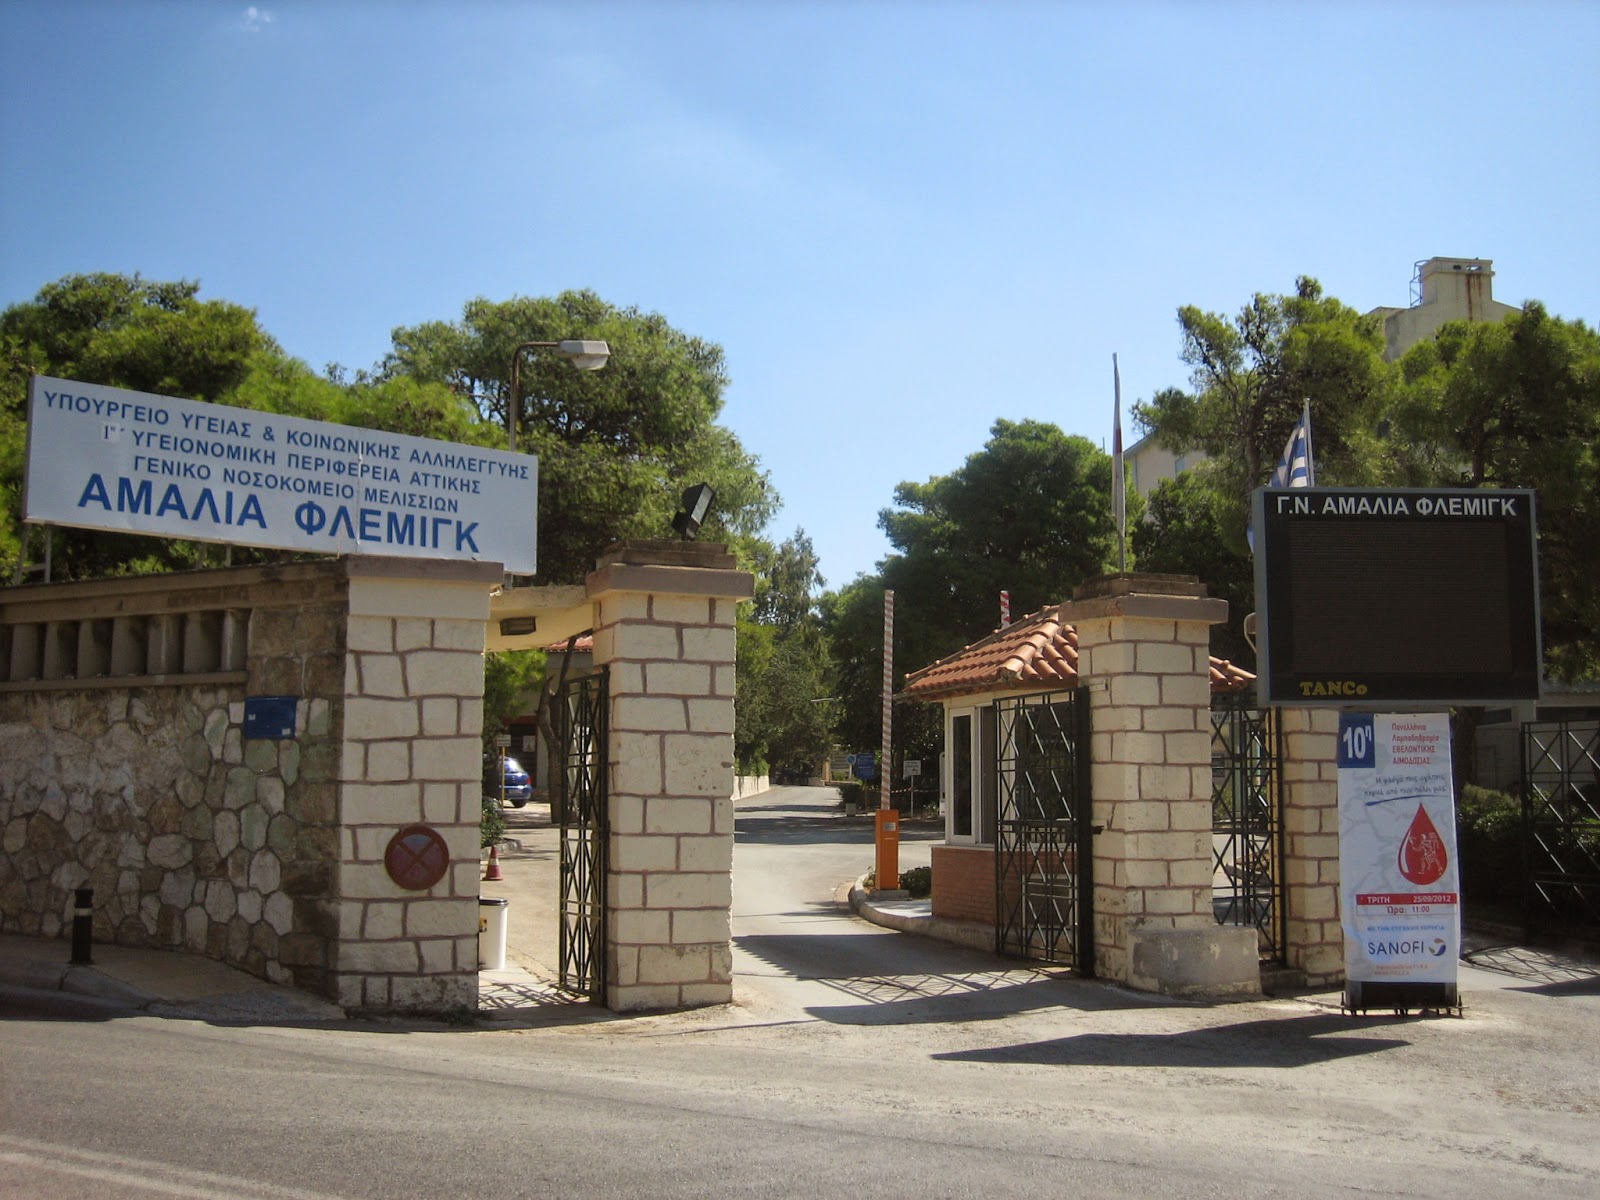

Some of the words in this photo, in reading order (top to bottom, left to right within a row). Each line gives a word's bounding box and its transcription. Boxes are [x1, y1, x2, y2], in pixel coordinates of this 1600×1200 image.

[44, 391, 169, 425] ΥΠΟΥΡΓΕΙΟ
[181, 413, 251, 438] ΥΓΕΙΑΣ
[263, 426, 275, 441] &
[287, 430, 400, 461] ΚΟΙΝΩΝΙΚΗΣ
[409, 449, 529, 480] ΑΛΛΗΛΕΓΓΥΗΣ
[132, 430, 275, 466] ΥΓΕΙΟΝΟΜΙΚΗ
[288, 453, 400, 483] ΠΕΡΙΦΕΡΕΙΑ
[410, 471, 480, 494] ΑΤΤΙΚΗΣ
[134, 456, 211, 480] ΓΕΝΙΚΟ
[223, 468, 354, 499] ΝΟΣΟΚΟΜΕΙΟ
[364, 487, 458, 513] ΜΕΛΙΣΣΙΩΝ
[77, 473, 267, 529] ΑΜΑΛΙΑ
[294, 500, 480, 553] ΦΛΕΜΙΓΚ
[1277, 496, 1315, 514] Γ.Ν.
[1322, 497, 1409, 515] ΑΜΑΛΙΑ
[1415, 498, 1516, 516] ΦΛΕΜΙΓΚ
[1300, 681, 1367, 695] TANCo
[1343, 725, 1372, 759] 10η
[1412, 905, 1430, 913] 11:00
[1368, 941, 1424, 955] SANOFI
